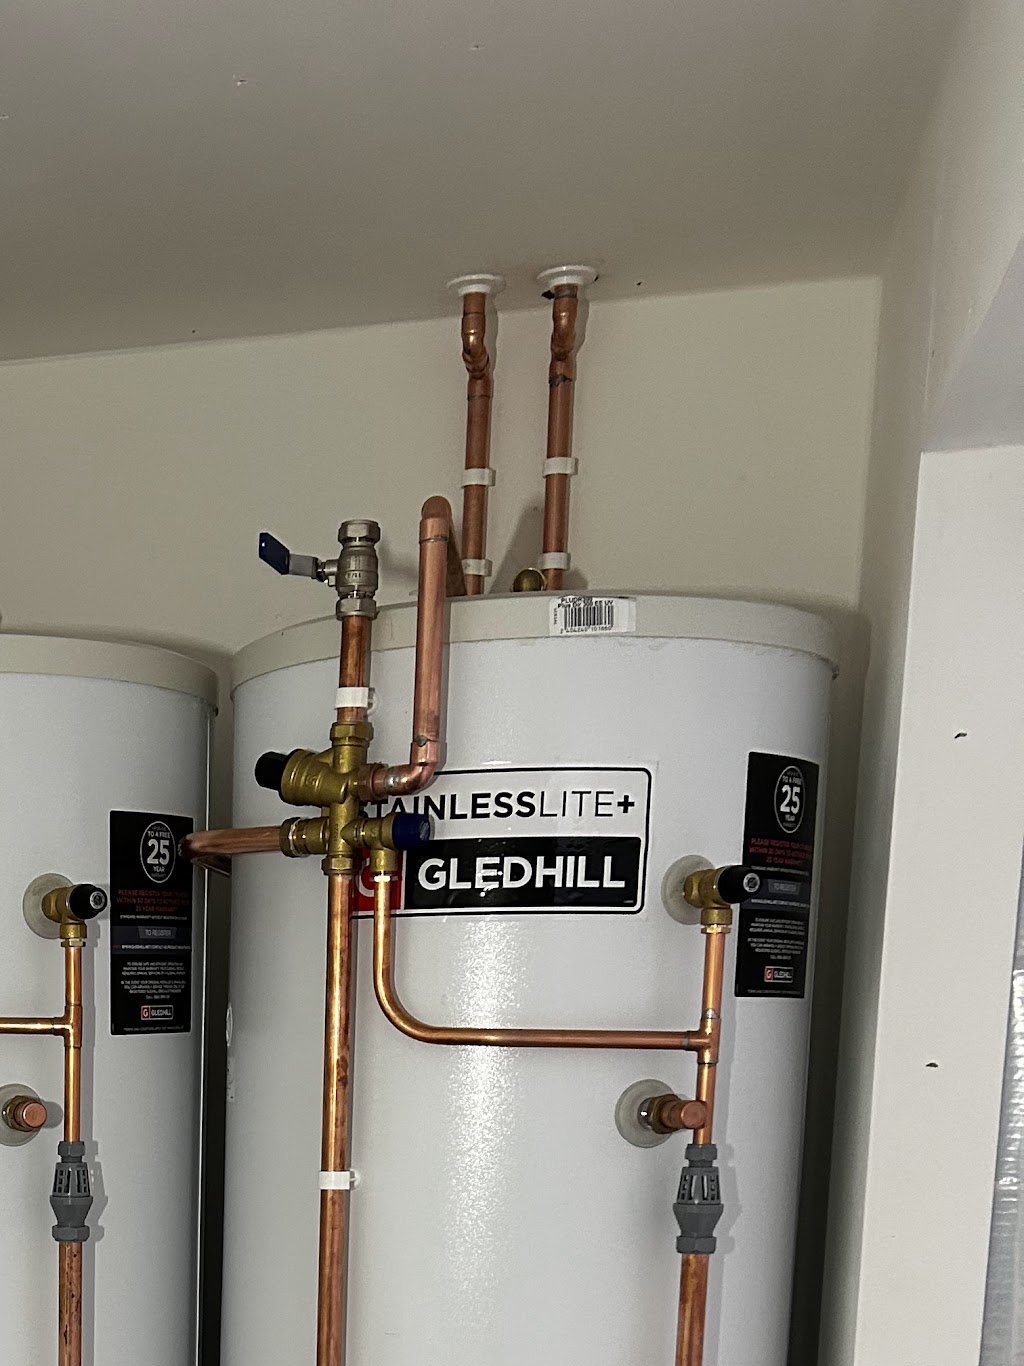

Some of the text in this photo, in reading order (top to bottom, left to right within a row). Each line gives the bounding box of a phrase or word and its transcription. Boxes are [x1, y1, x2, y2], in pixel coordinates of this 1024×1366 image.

[358, 791, 636, 821] TAINLESSLITE+
[780, 784, 801, 815] 25
[147, 830, 155, 838] TO
[159, 831, 171, 839] FREE
[146, 838, 170, 866] 25
[152, 865, 166, 873] YEAR
[418, 855, 626, 891] GLEDHILL
[142, 1008, 172, 1018] G GLEDHILL
